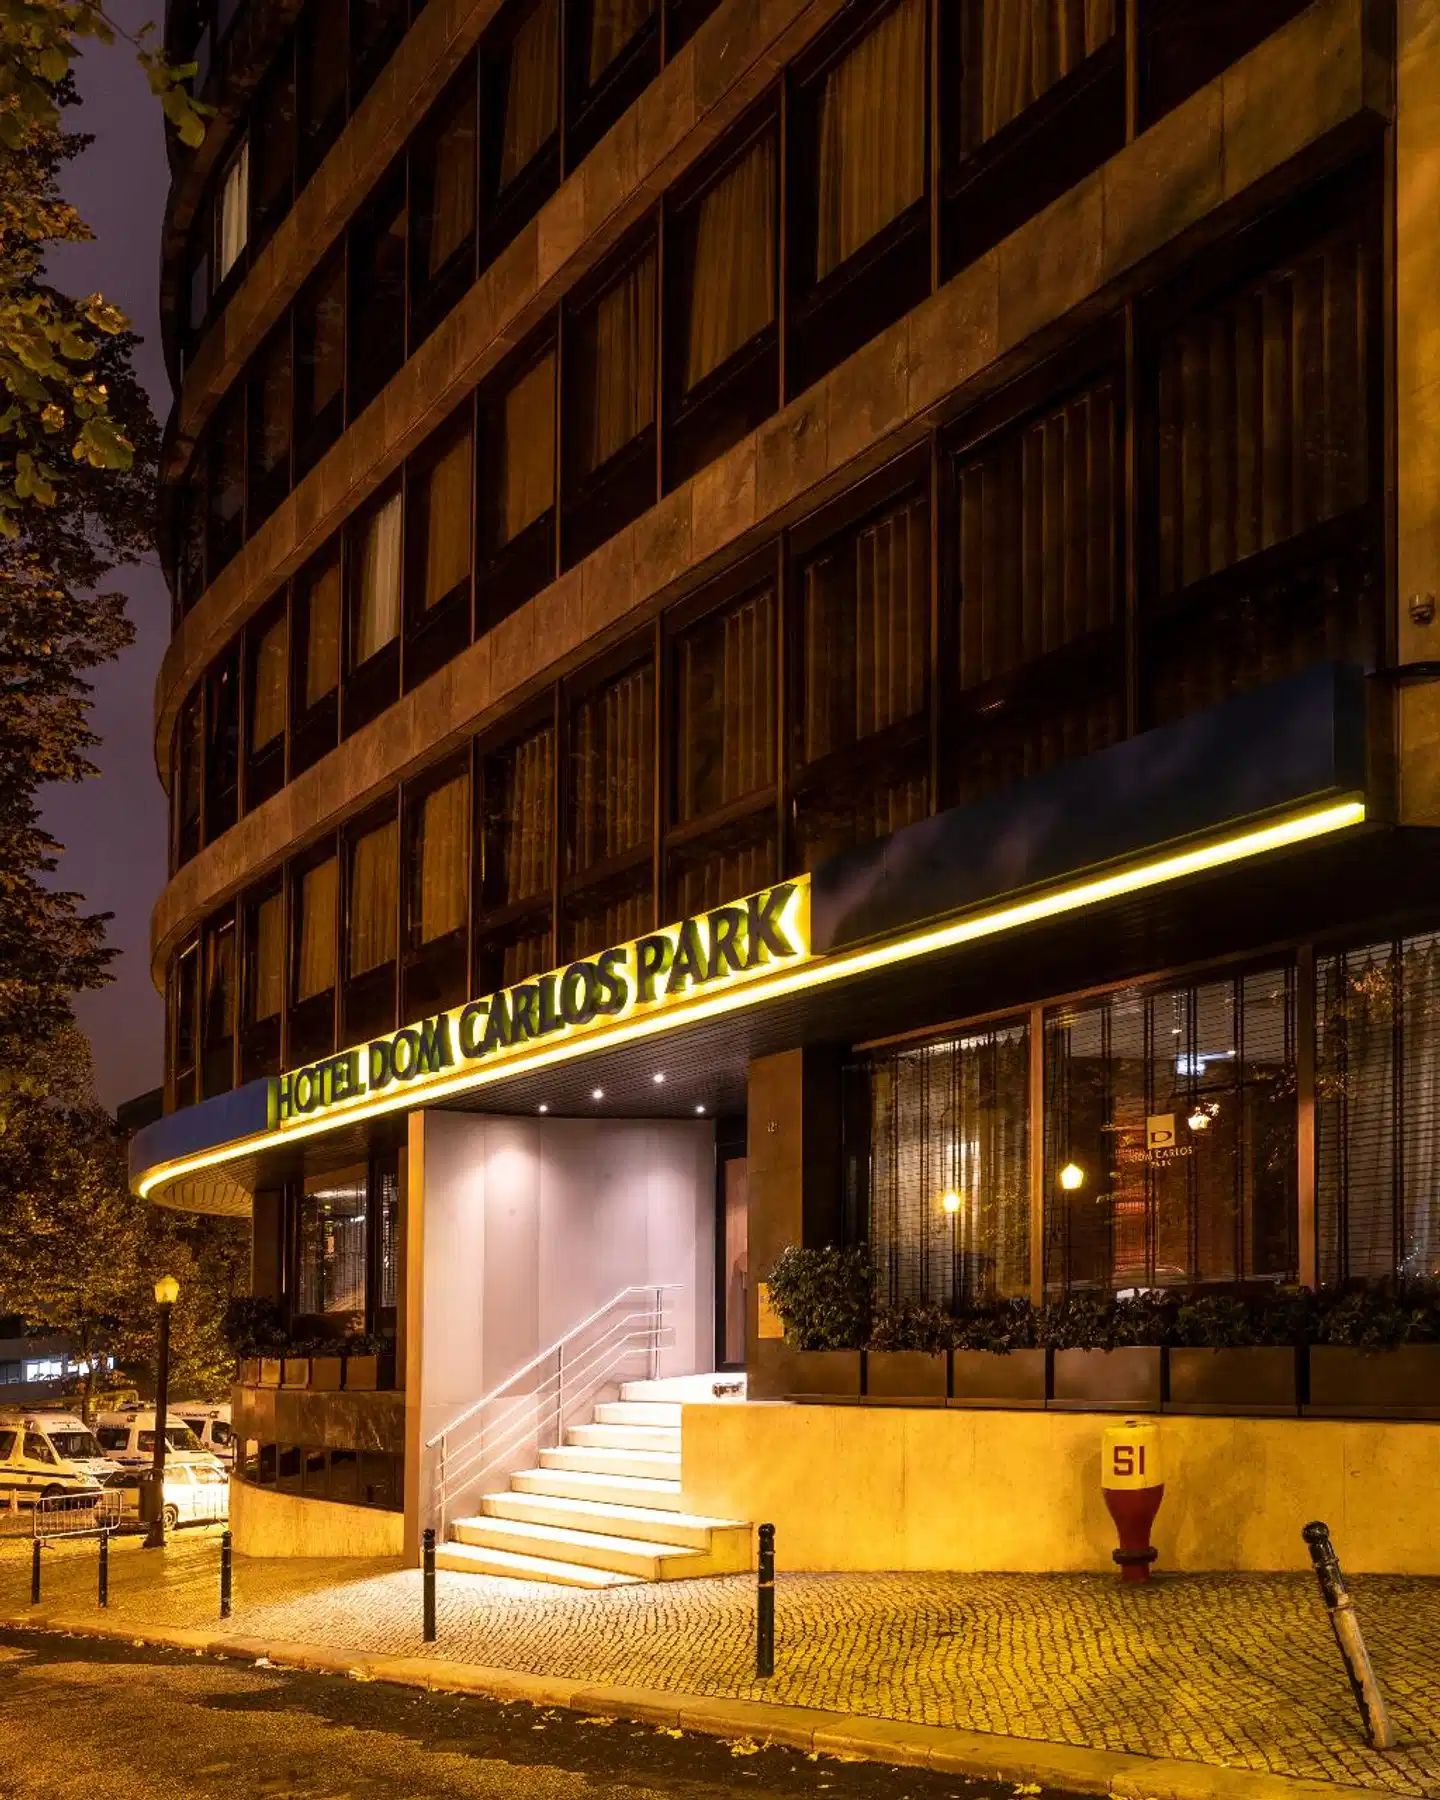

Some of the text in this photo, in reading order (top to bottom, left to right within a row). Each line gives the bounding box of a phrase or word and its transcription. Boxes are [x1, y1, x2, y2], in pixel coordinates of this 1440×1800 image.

[278, 883, 799, 1119] HOTEL DOM CARLOS PARK
[1150, 1131, 1172, 1142] D
[1155, 1146, 1193, 1159] CARLOS
